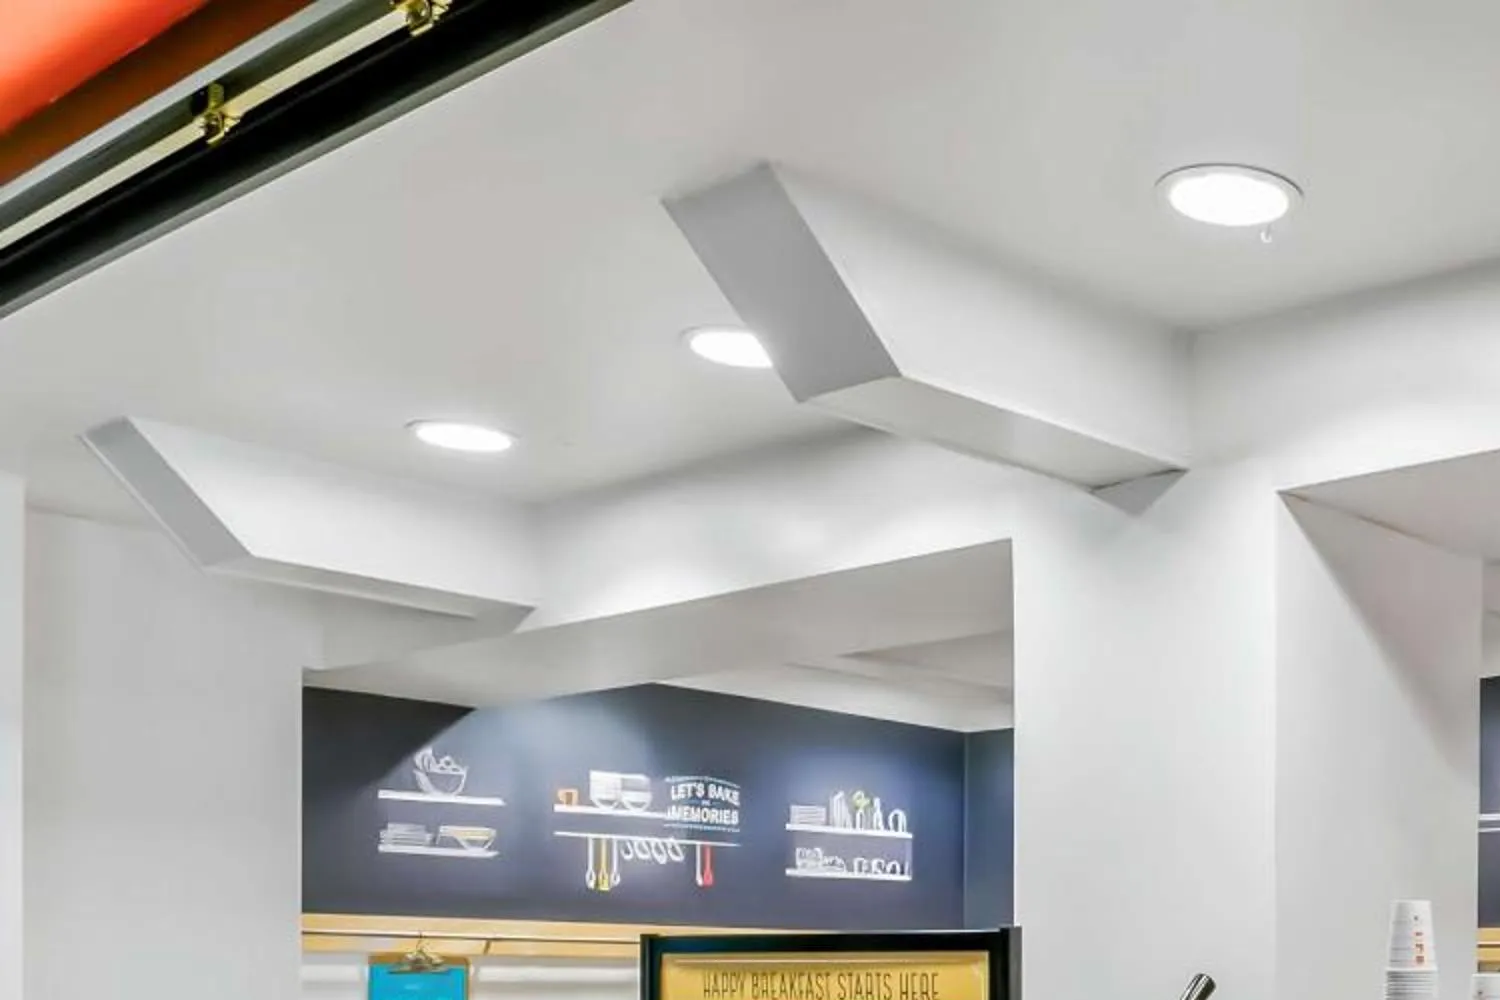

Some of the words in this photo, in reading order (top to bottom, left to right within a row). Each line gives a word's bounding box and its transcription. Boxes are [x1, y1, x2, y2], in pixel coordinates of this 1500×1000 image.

[671, 782, 705, 800] LET'S
[708, 783, 740, 806] BAKE
[667, 804, 739, 825] MEMORIES
[703, 971, 745, 999] HAPPY
[751, 971, 831, 1000] BREAKFAST
